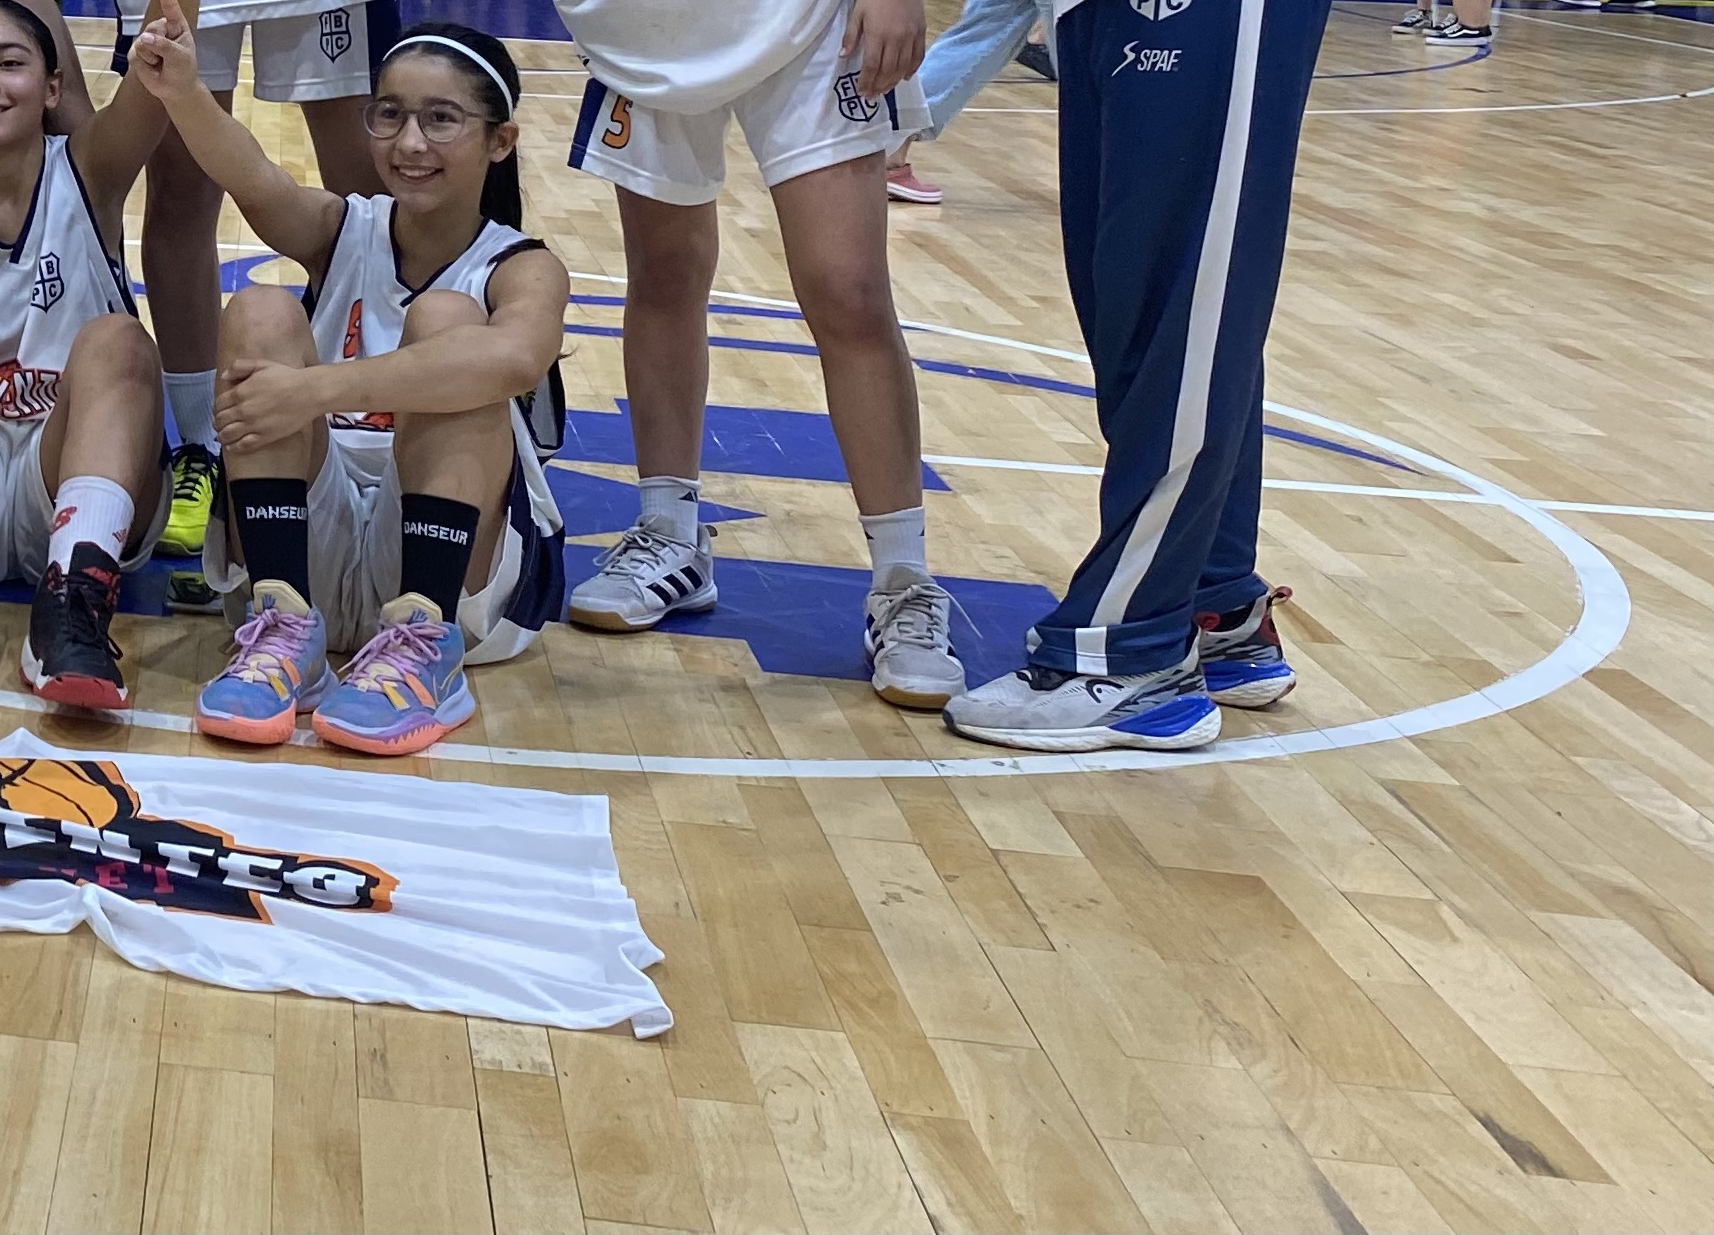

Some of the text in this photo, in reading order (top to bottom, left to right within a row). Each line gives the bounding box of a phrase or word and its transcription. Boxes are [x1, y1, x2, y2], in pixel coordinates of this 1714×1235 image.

[1137, 49, 1182, 72] SPAF
[601, 96, 633, 150] 5
[404, 521, 468, 546] DANSEUR
